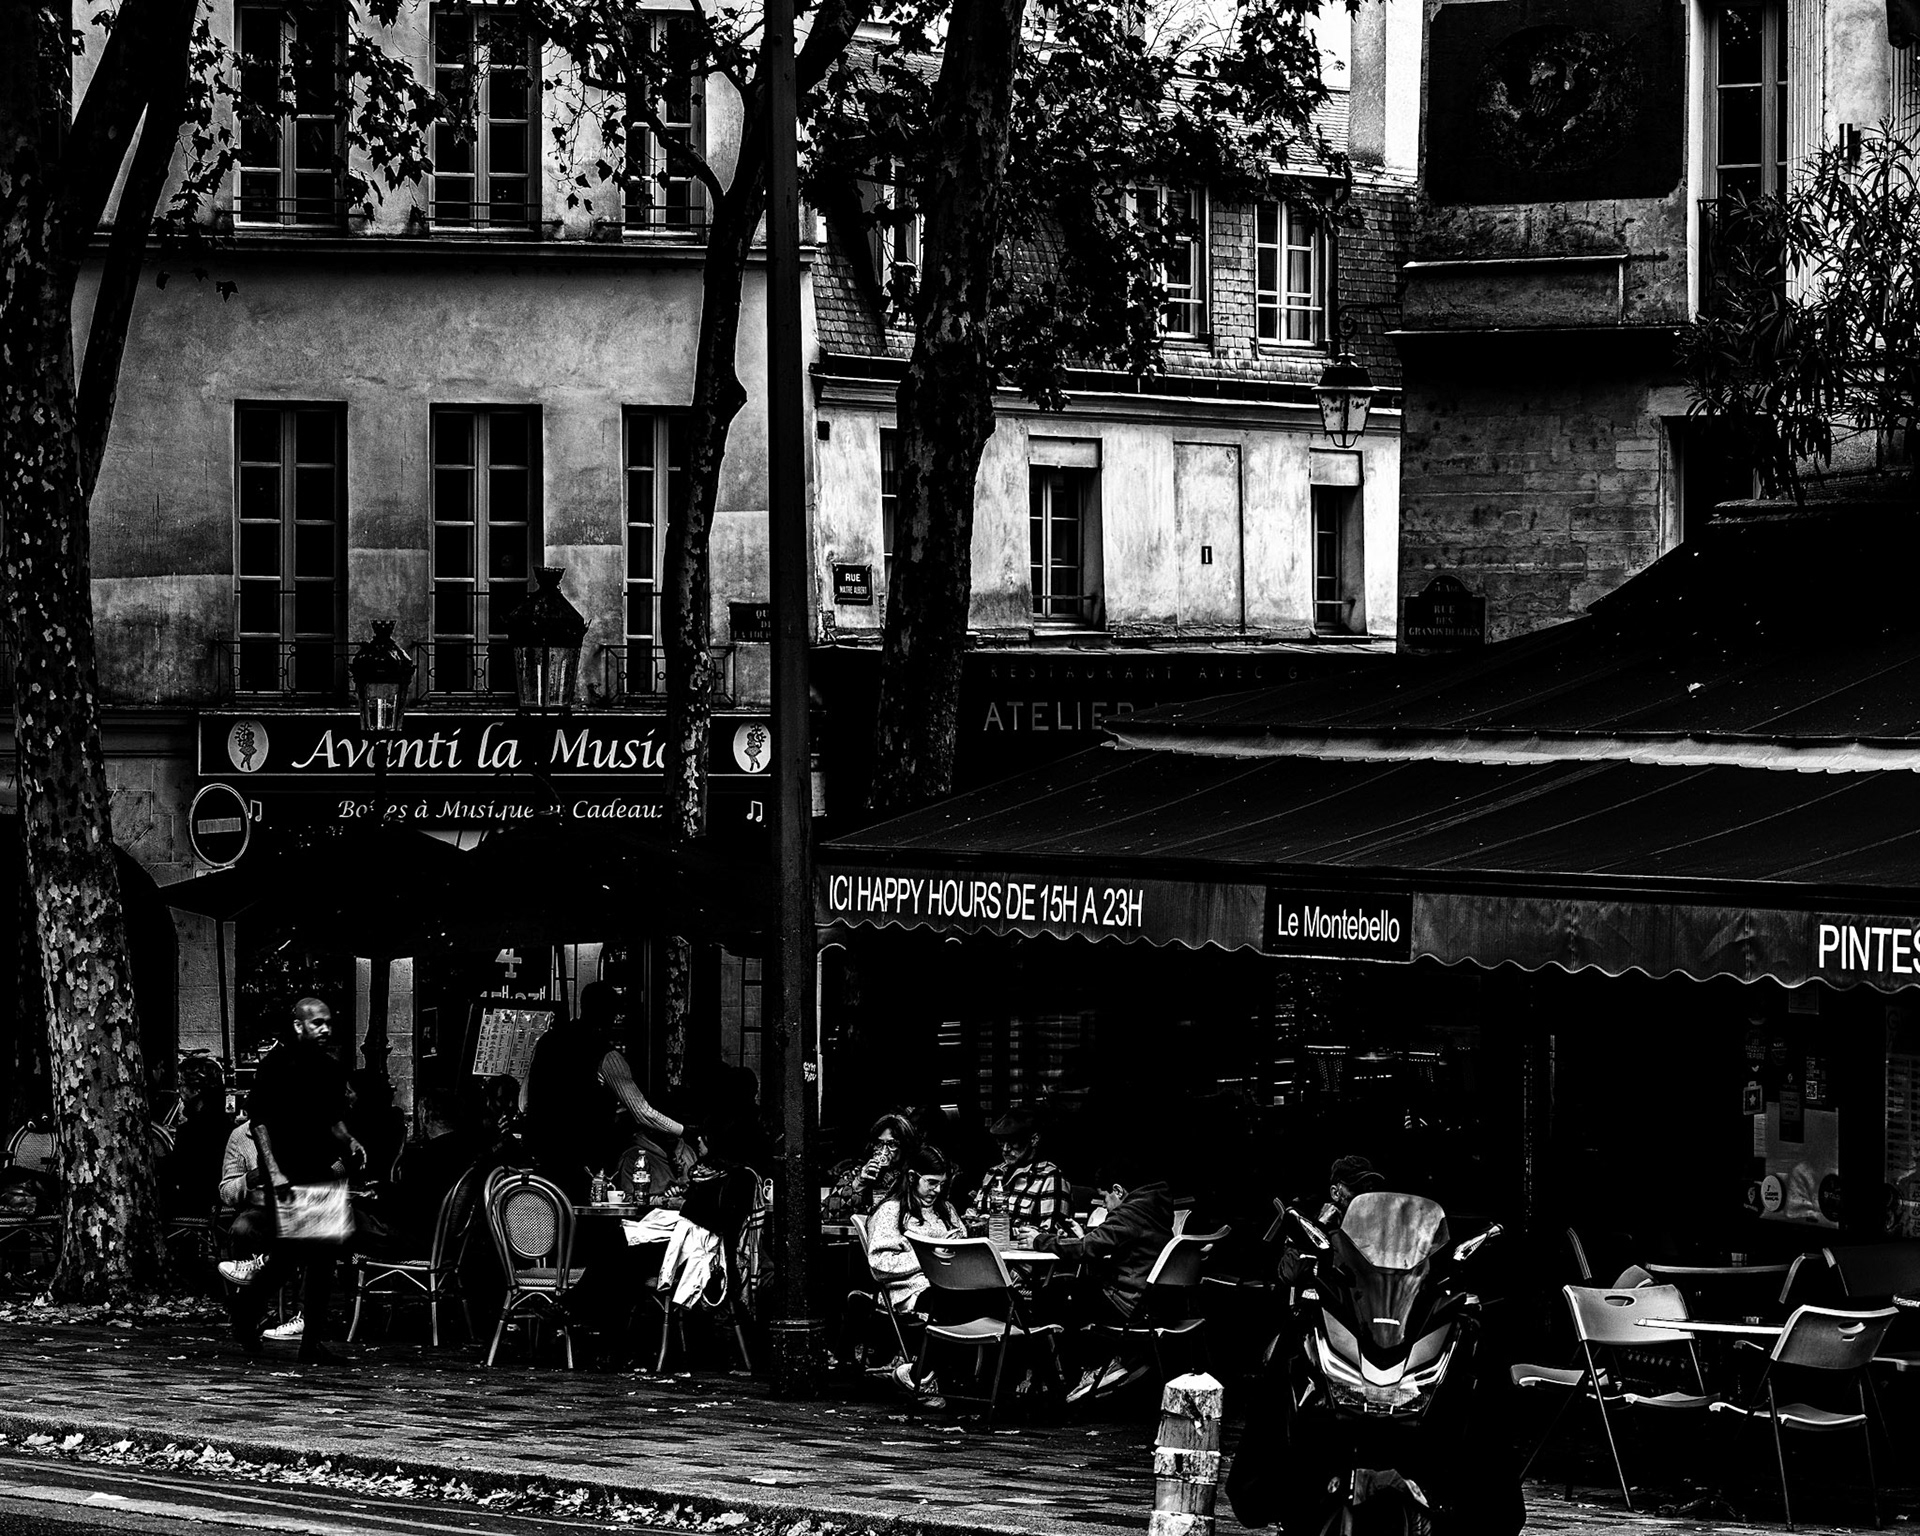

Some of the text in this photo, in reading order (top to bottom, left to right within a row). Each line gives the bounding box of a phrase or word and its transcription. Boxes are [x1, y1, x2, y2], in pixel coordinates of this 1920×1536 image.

[845, 573, 862, 582] RUE
[1433, 605, 1456, 614] RUE
[990, 664, 1173, 680] RESTAURANT
[1199, 665, 1263, 680] AVEC
[290, 727, 463, 769] Avanti
[477, 721, 522, 769] la
[337, 800, 409, 820] Boes
[413, 799, 430, 819] à
[828, 874, 1144, 928] ICI HAPPY HOURS DE 15H A 23H
[1277, 903, 1401, 944] Le Montebello
